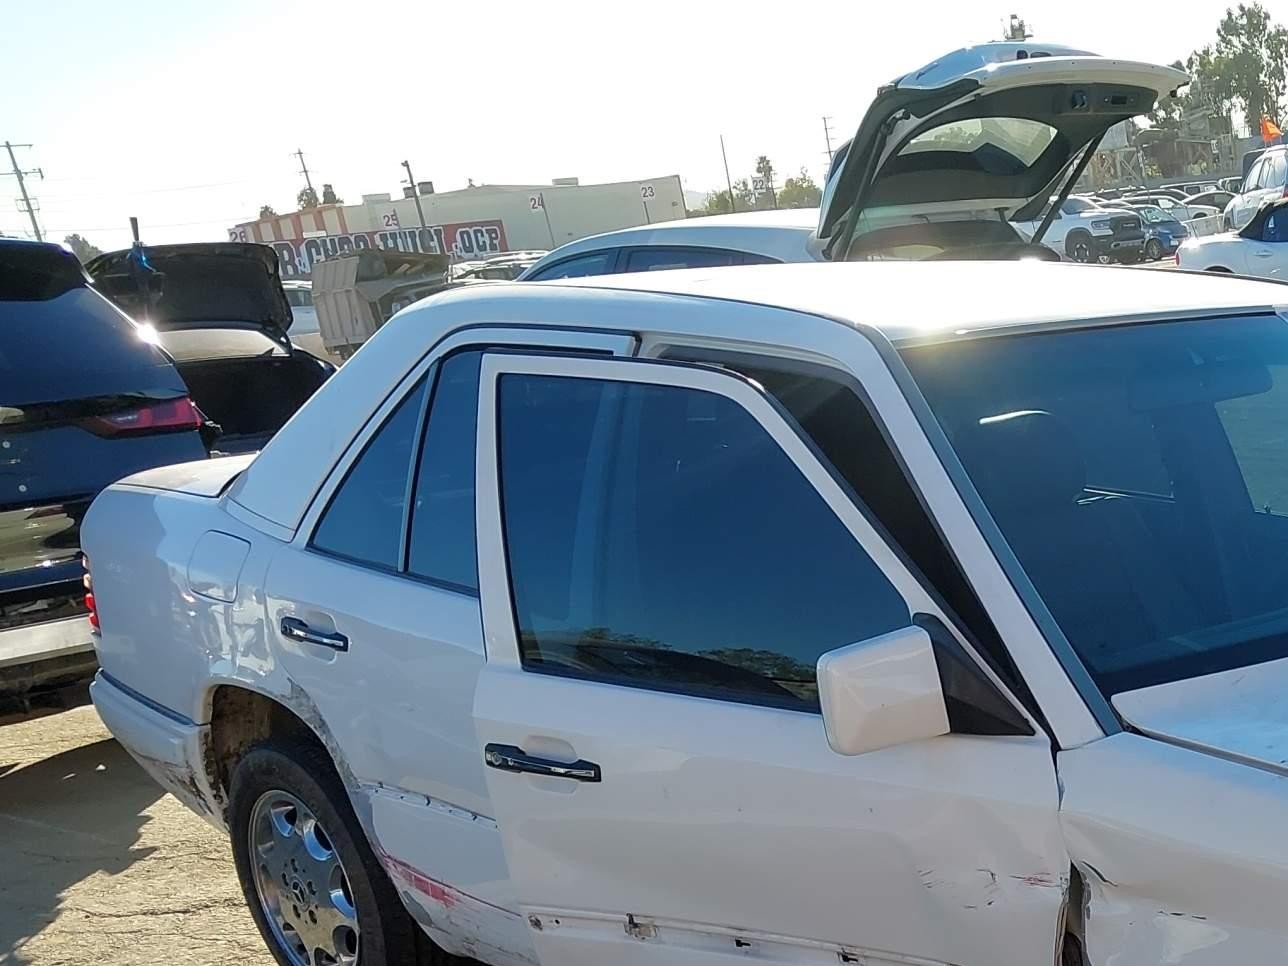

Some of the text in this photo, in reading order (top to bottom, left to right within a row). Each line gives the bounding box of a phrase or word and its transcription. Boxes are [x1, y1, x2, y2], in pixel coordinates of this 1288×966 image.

[752, 179, 764, 190] 22
[641, 186, 655, 198] 23
[530, 197, 544, 209] 24
[383, 214, 399, 227] 25
